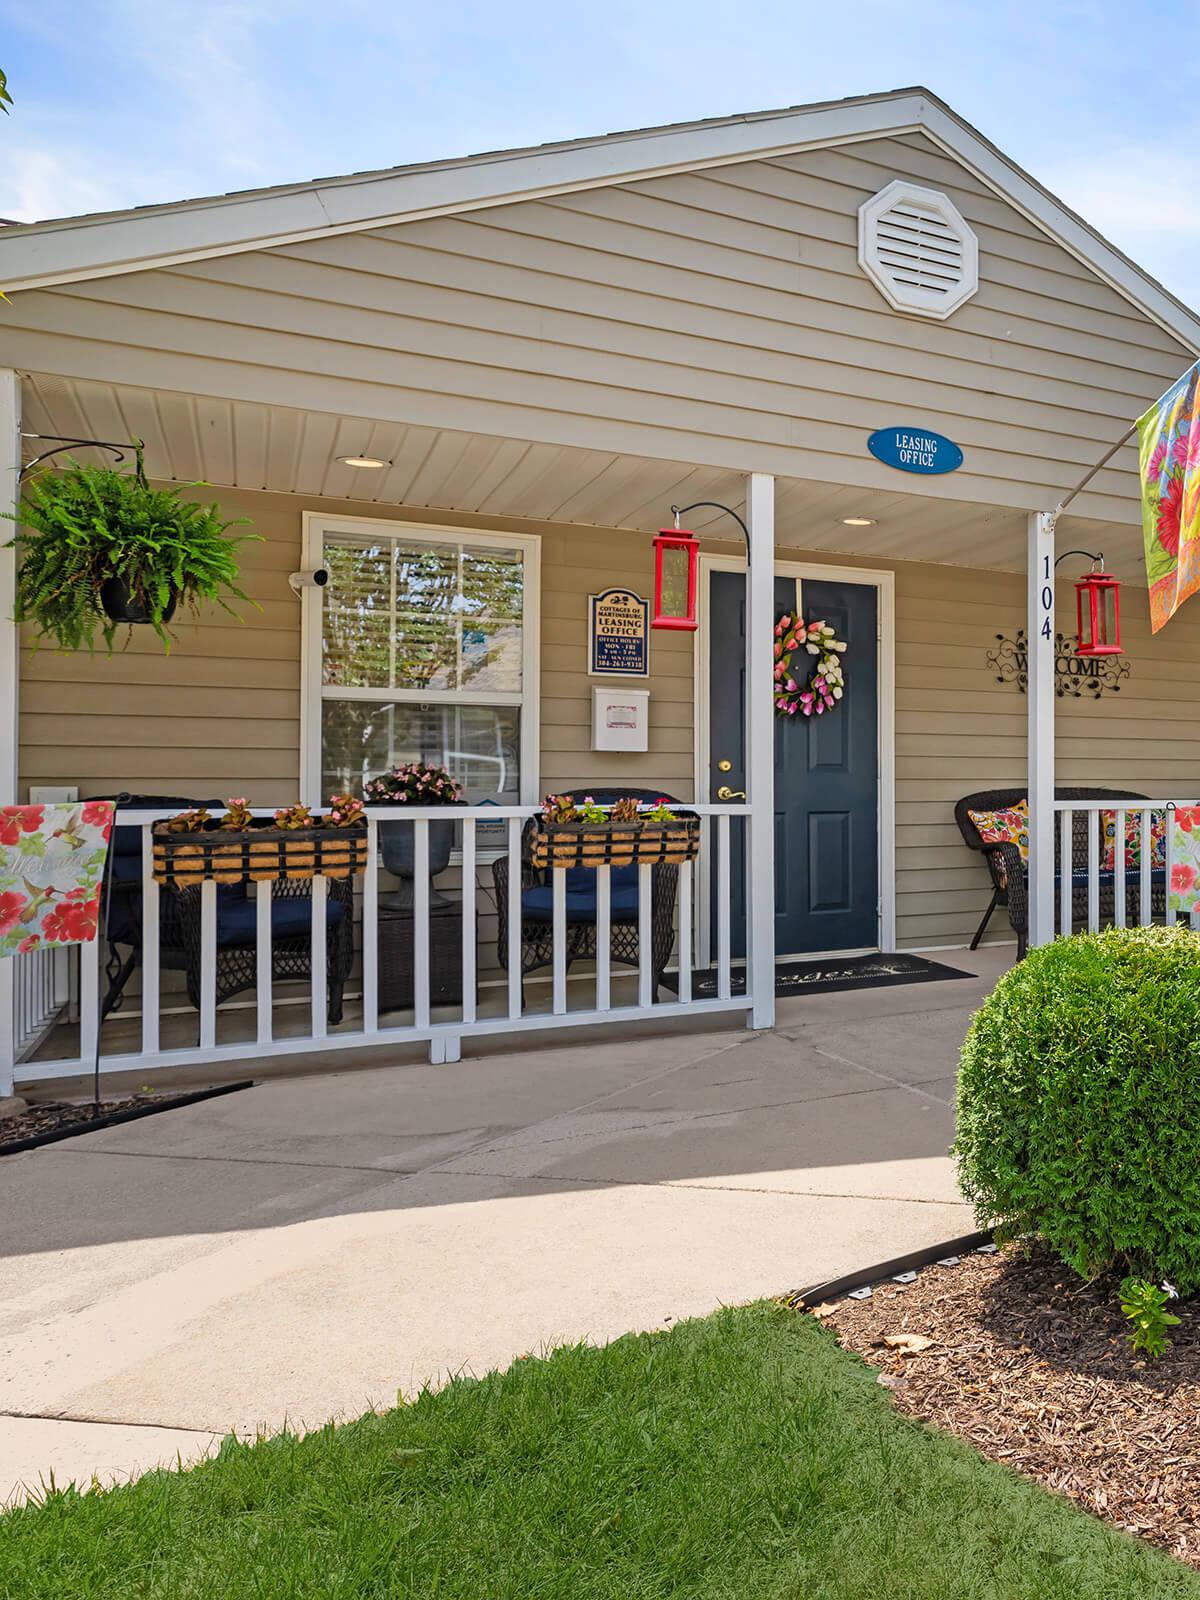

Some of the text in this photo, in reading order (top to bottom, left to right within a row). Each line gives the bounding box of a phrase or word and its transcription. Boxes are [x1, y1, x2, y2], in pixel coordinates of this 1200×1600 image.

[896, 434, 937, 453] LEASING
[900, 449, 934, 467] OFFICE
[1041, 555, 1053, 640] 104
[598, 611, 642, 619] MARTINSBURG
[599, 618, 642, 628] LEASING
[602, 626, 639, 636] OFFICE
[1013, 652, 1107, 678] WCOME
